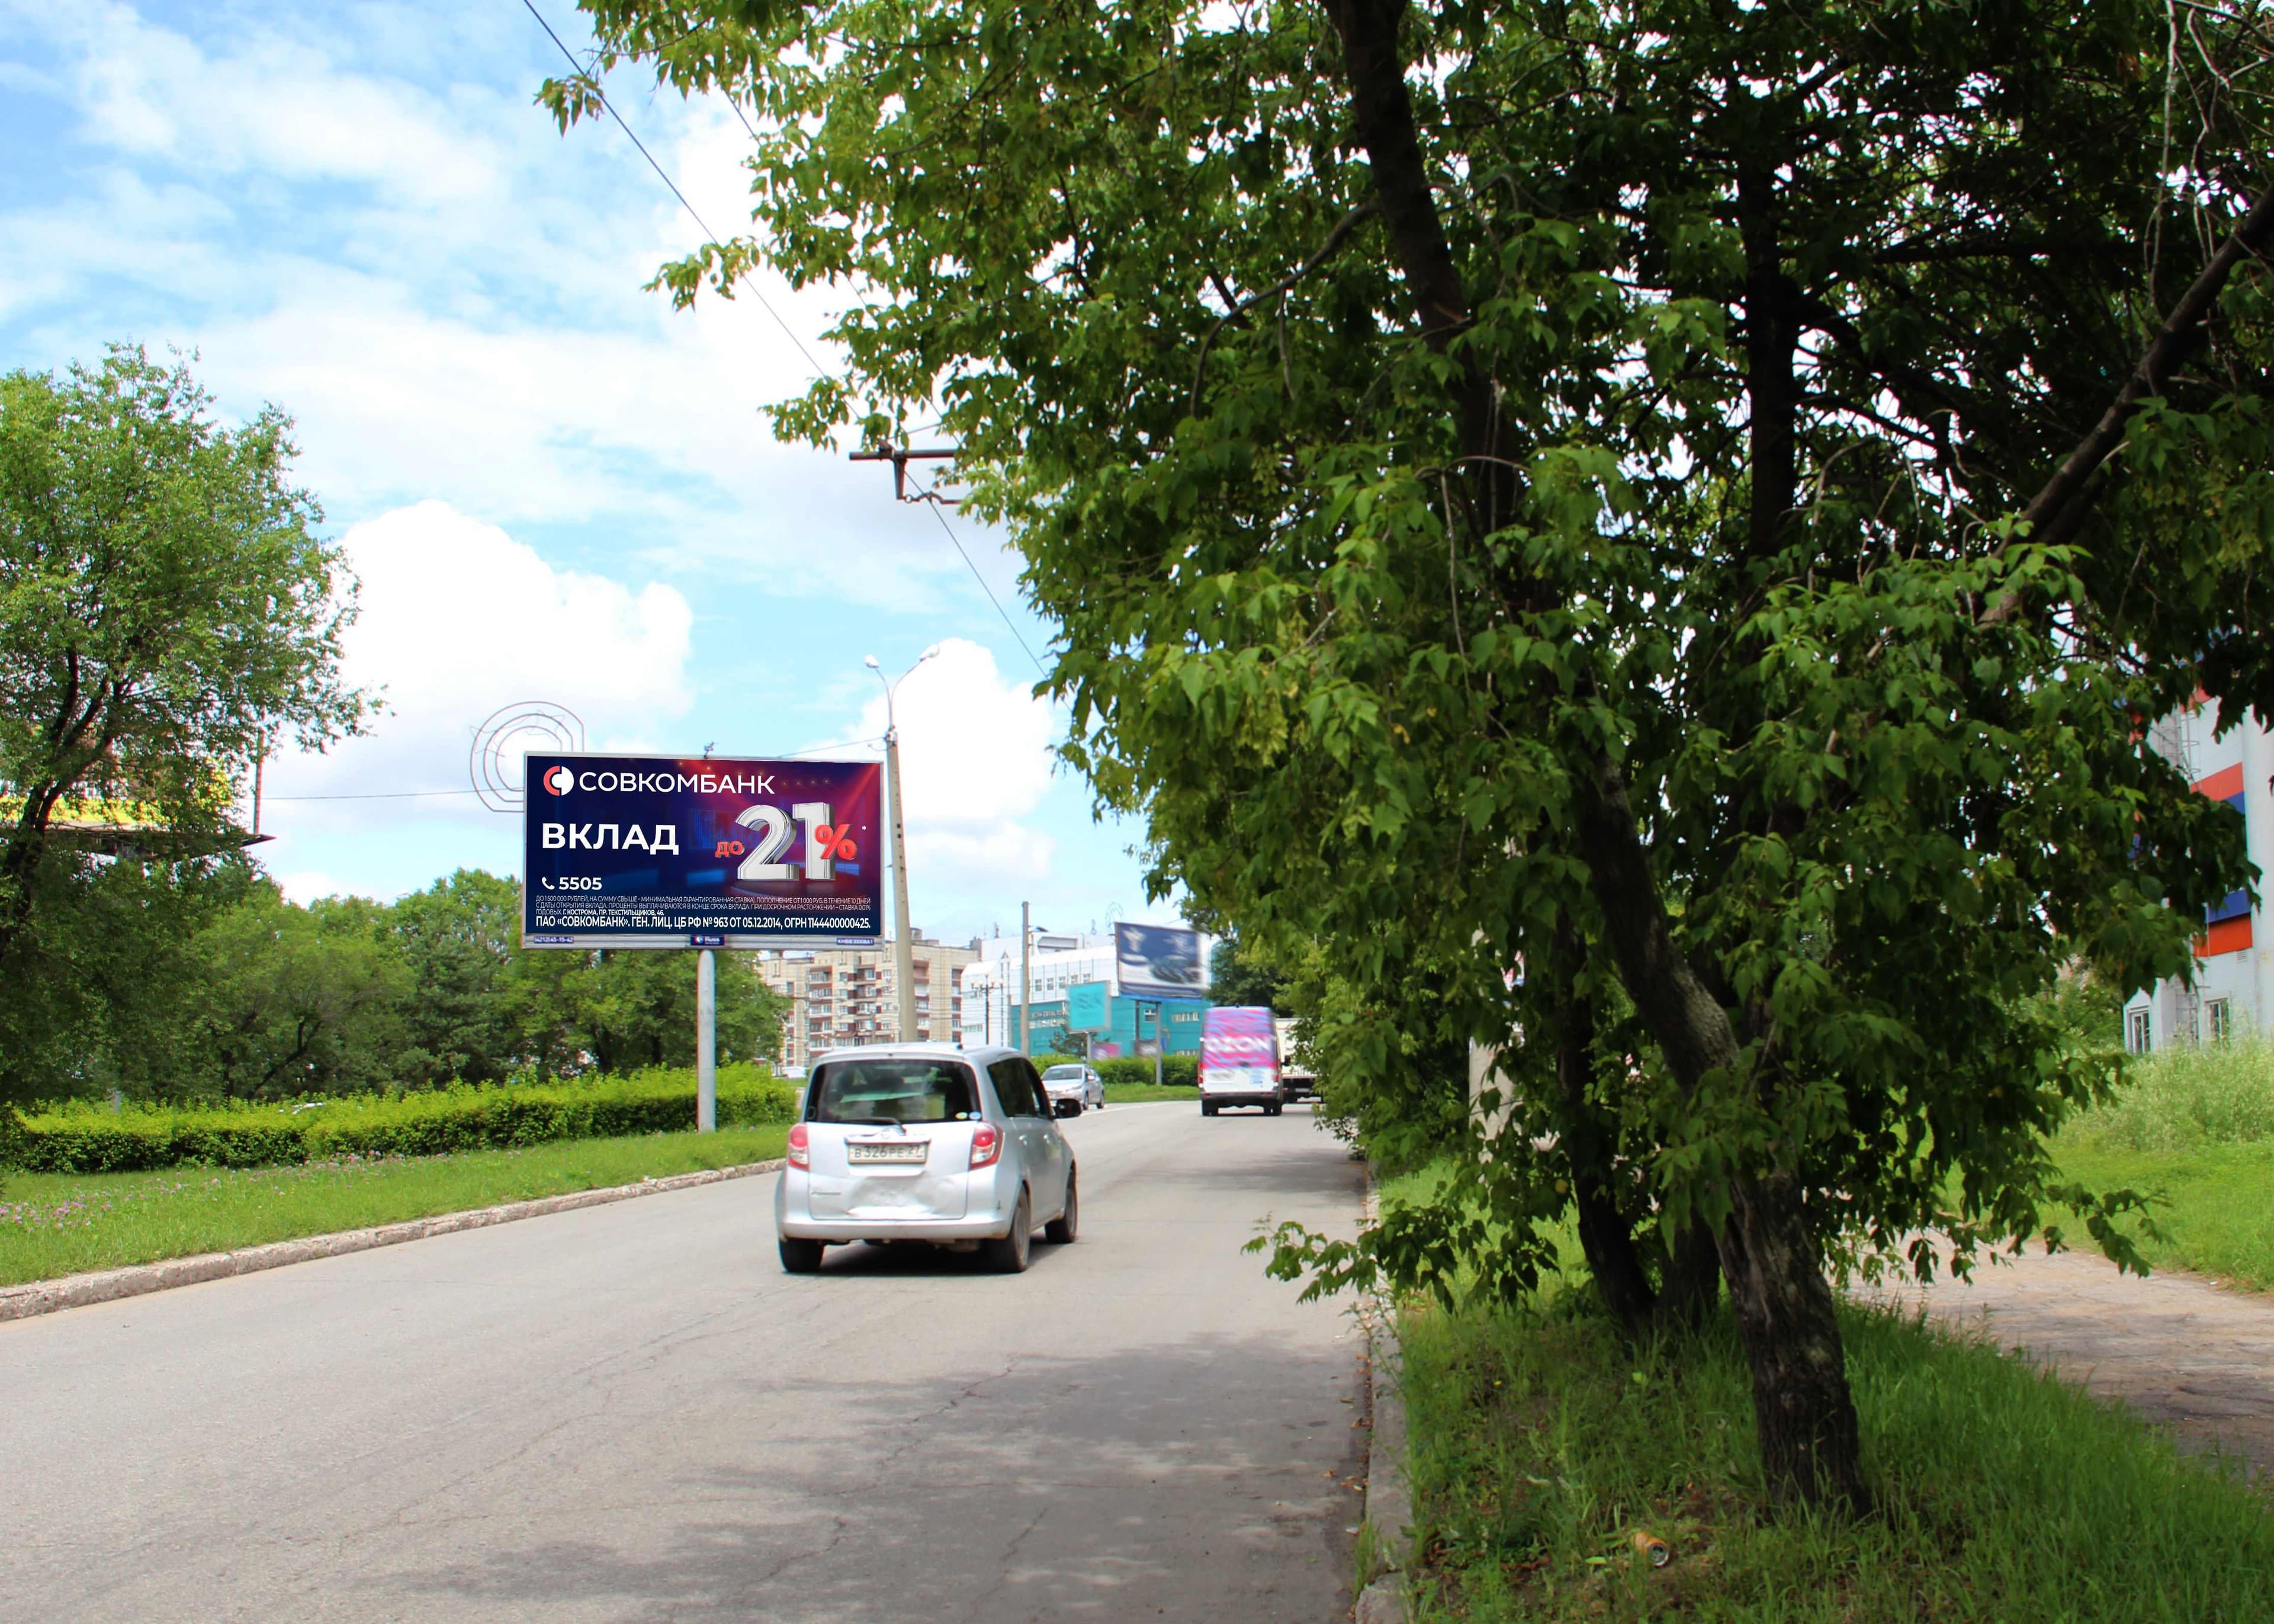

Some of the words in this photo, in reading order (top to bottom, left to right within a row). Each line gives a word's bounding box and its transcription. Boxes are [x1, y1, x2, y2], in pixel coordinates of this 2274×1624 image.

[579, 771, 775, 795] СОВКОМБАНК
[542, 823, 679, 855] ВКЛАД
[558, 876, 602, 890] 5505
[536, 916, 555, 927] ПАО
[557, 916, 630, 927] «СОВКОМБАНК».
[632, 916, 650, 927] ГЕН.
[651, 916, 673, 929] ЛИЦ.
[674, 917, 686, 929] ЦБ
[688, 916, 701, 928] РФ
[714, 917, 728, 928] 963
[730, 917, 741, 928] ОТ
[743, 917, 783, 930] 05.12.2014,
[784, 918, 807, 928] ОГРН
[808, 918, 871, 928] 1144400000425.
